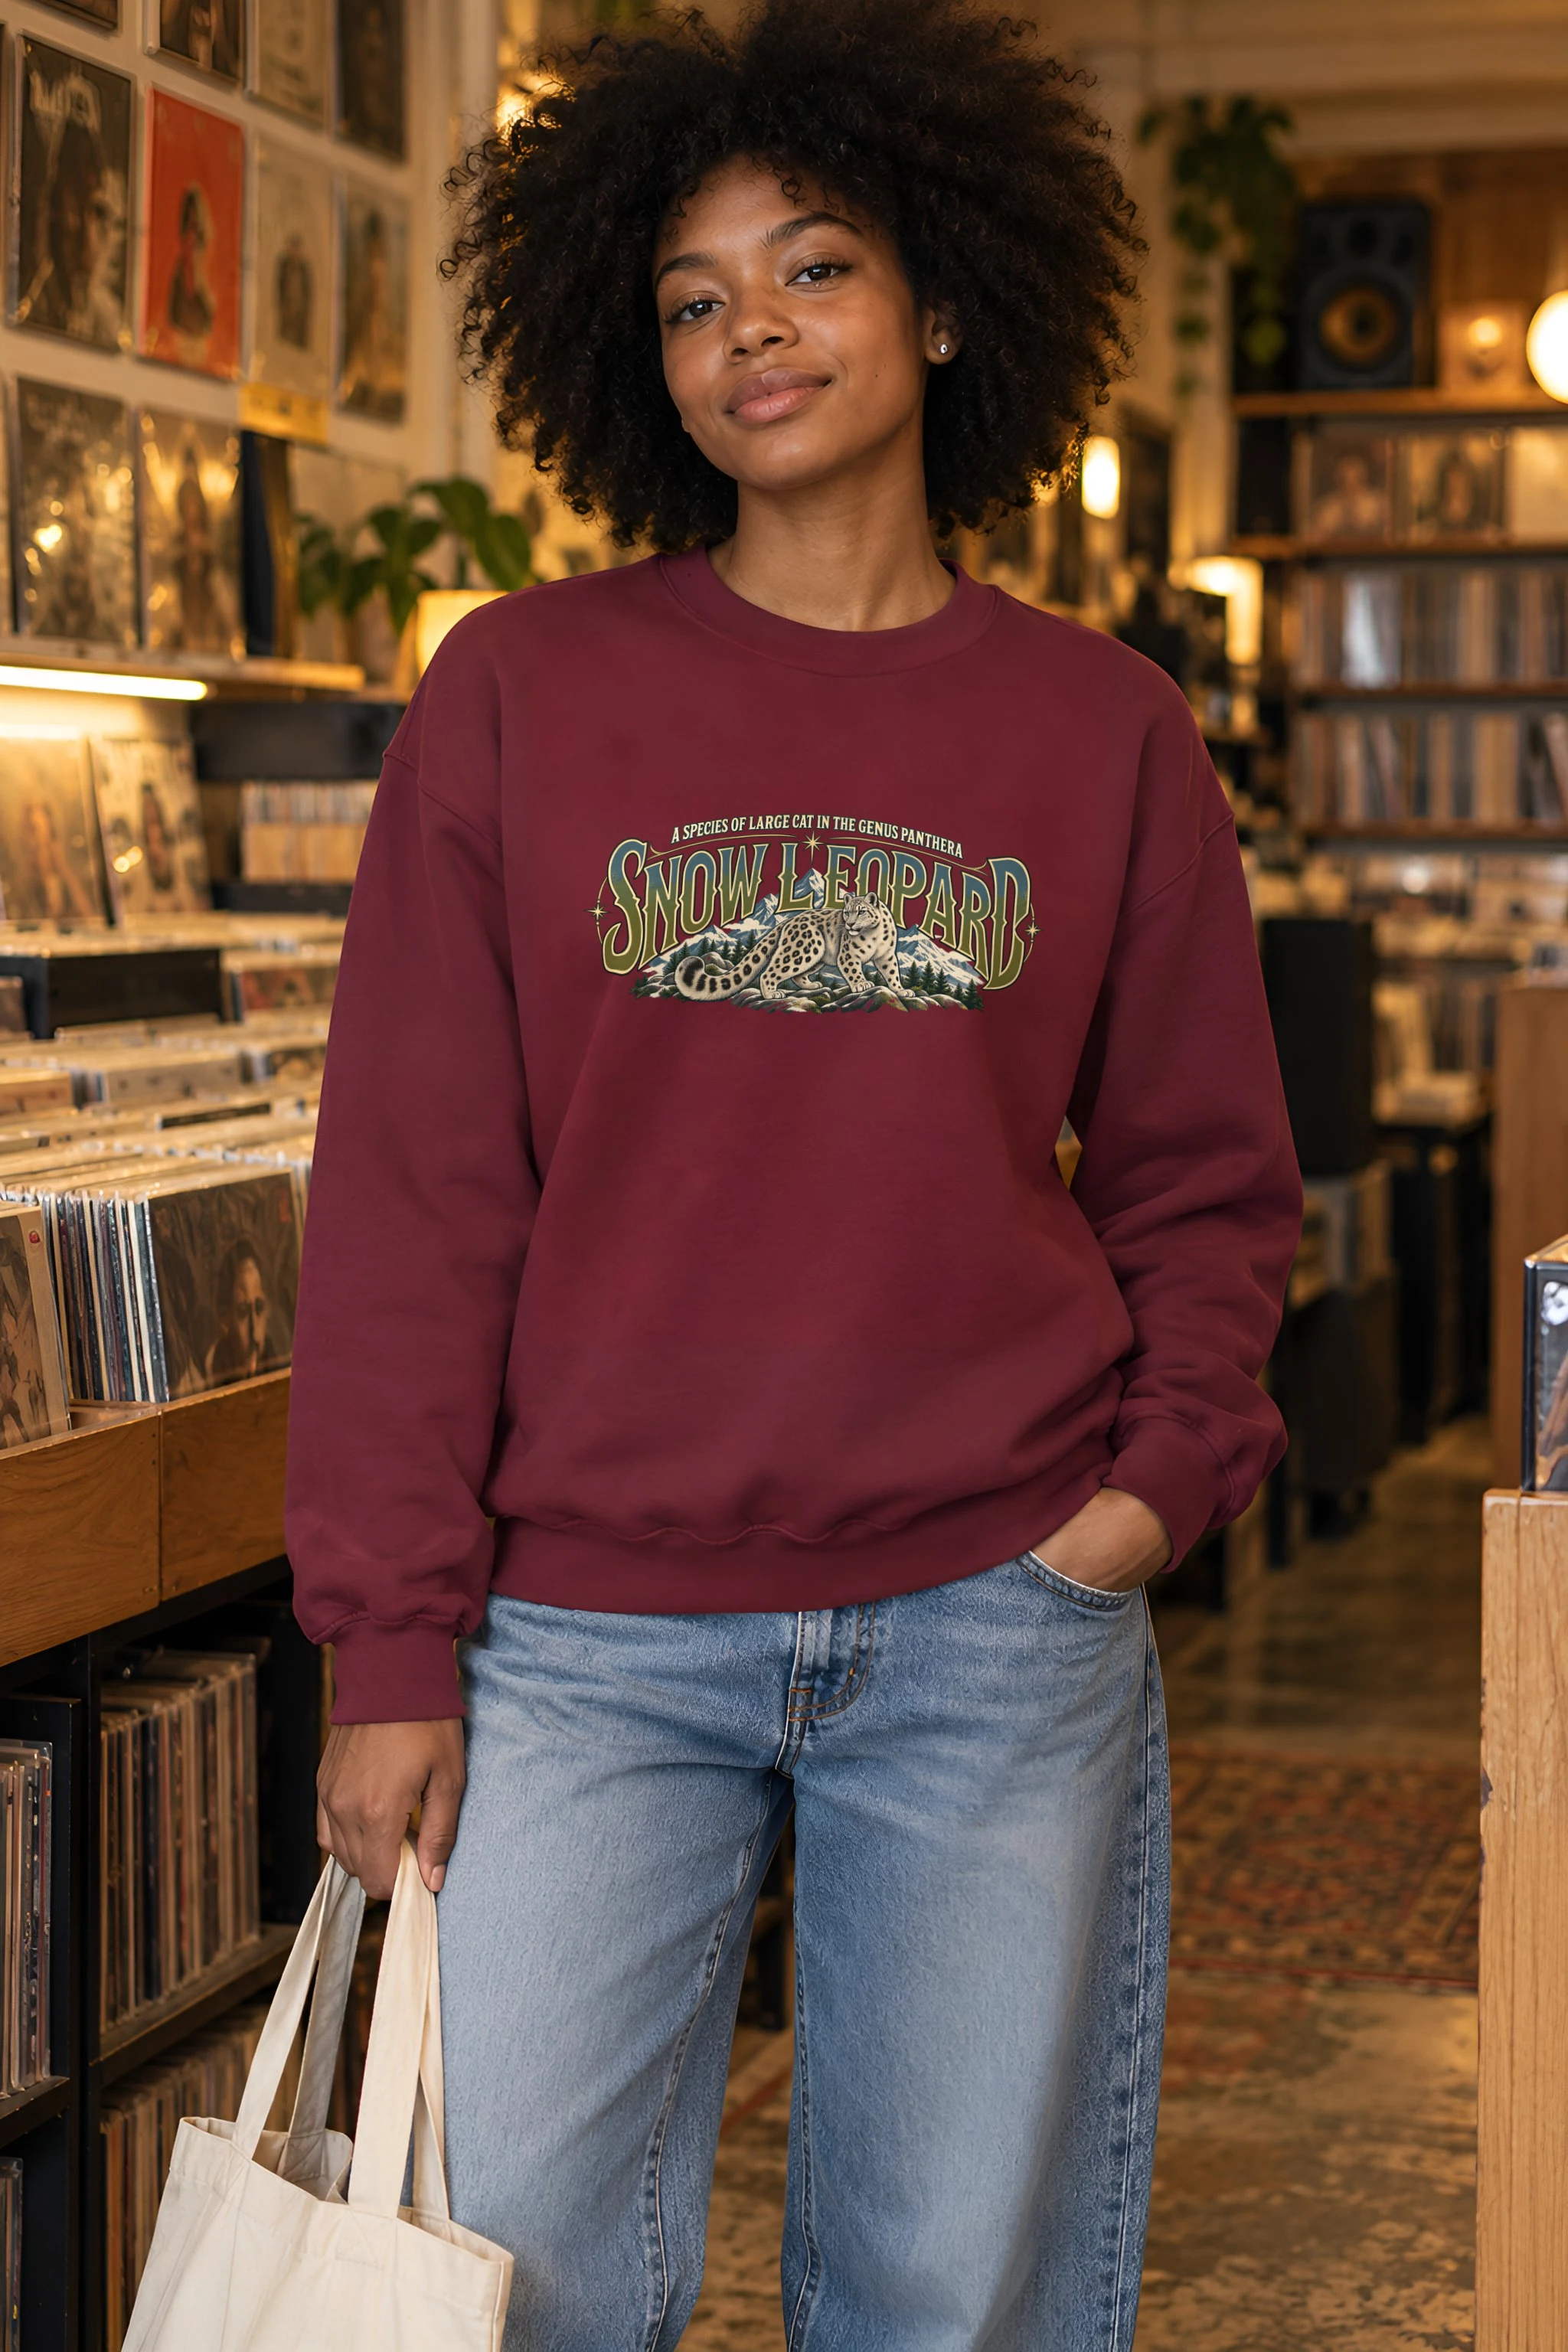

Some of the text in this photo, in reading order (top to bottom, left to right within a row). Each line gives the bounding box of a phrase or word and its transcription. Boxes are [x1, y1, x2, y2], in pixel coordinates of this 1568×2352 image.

[671, 814, 964, 859] A SPECIES OF LARGE CAT IN THE GENUS PANTHERA
[602, 838, 1031, 991] SNOW LEOPARD
